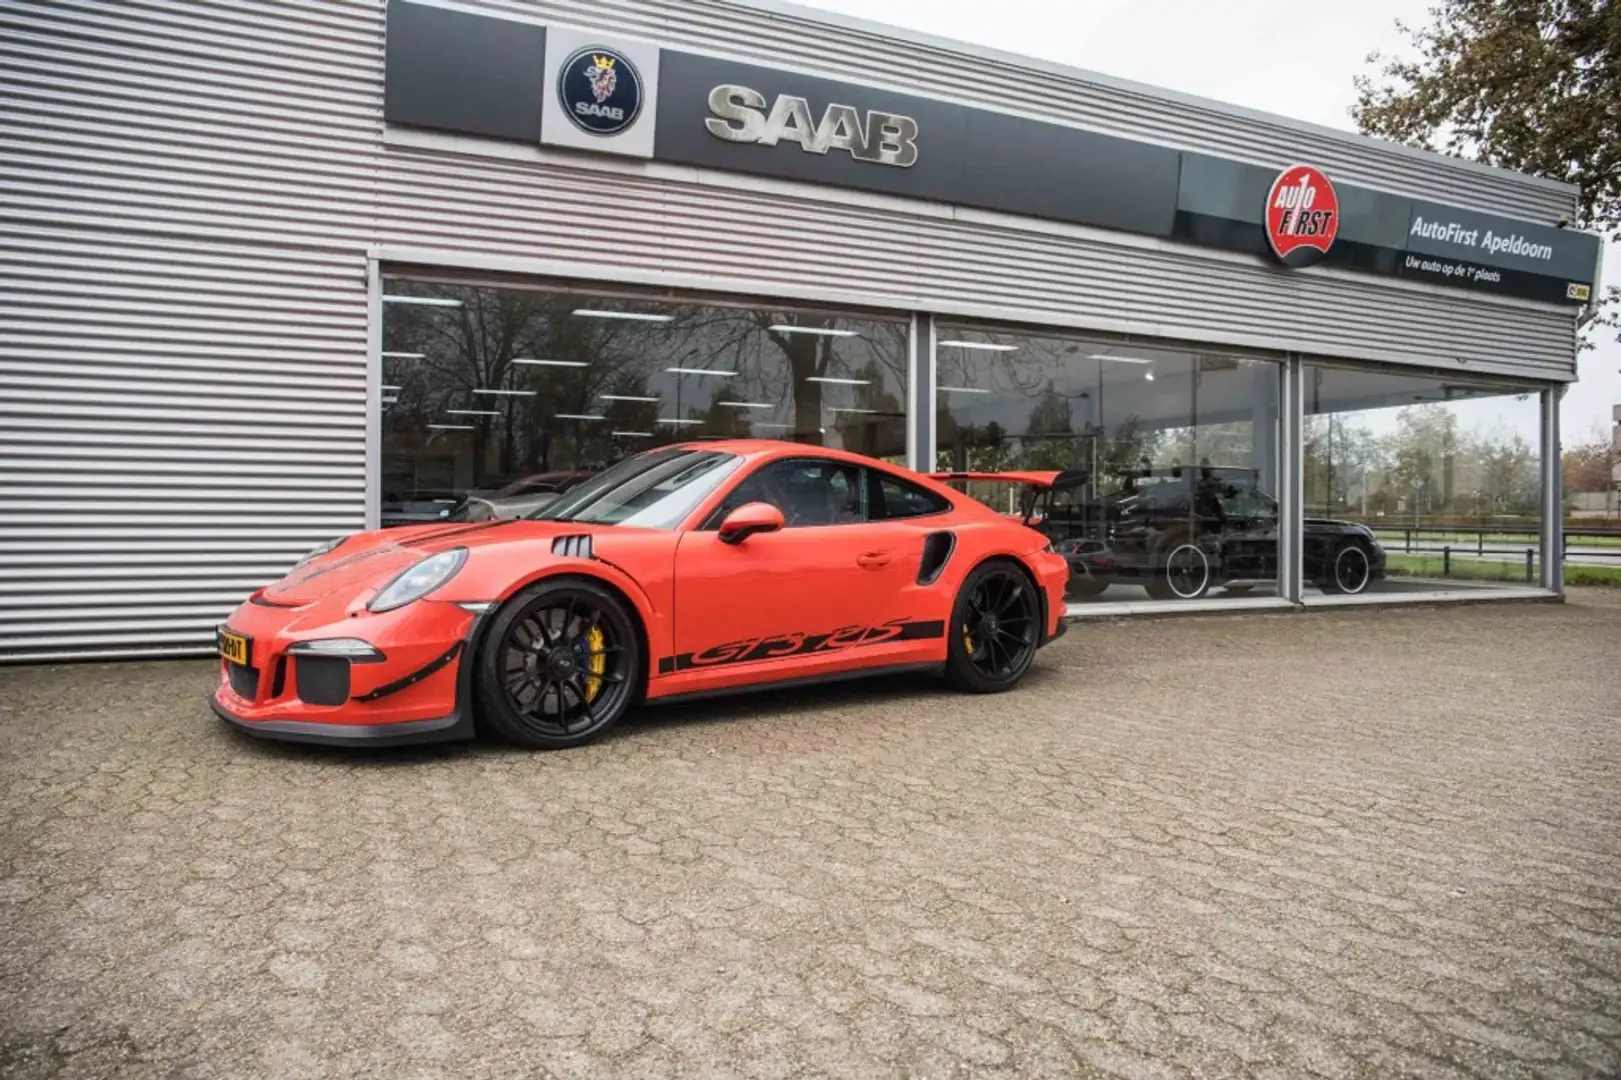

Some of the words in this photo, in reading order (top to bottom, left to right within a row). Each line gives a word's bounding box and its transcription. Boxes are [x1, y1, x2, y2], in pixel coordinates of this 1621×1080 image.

[575, 101, 624, 120] SAAB
[705, 84, 919, 167] SAAB
[1410, 216, 1478, 247] AutoFirst
[1480, 230, 1553, 260] Apeldoorn
[1405, 255, 1421, 268] Uw
[1421, 261, 1441, 272] auto
[1442, 264, 1454, 276] op
[1454, 264, 1466, 276] de
[1474, 268, 1501, 282] plaats
[691, 632, 806, 665] GT3
[816, 616, 912, 649] RS
